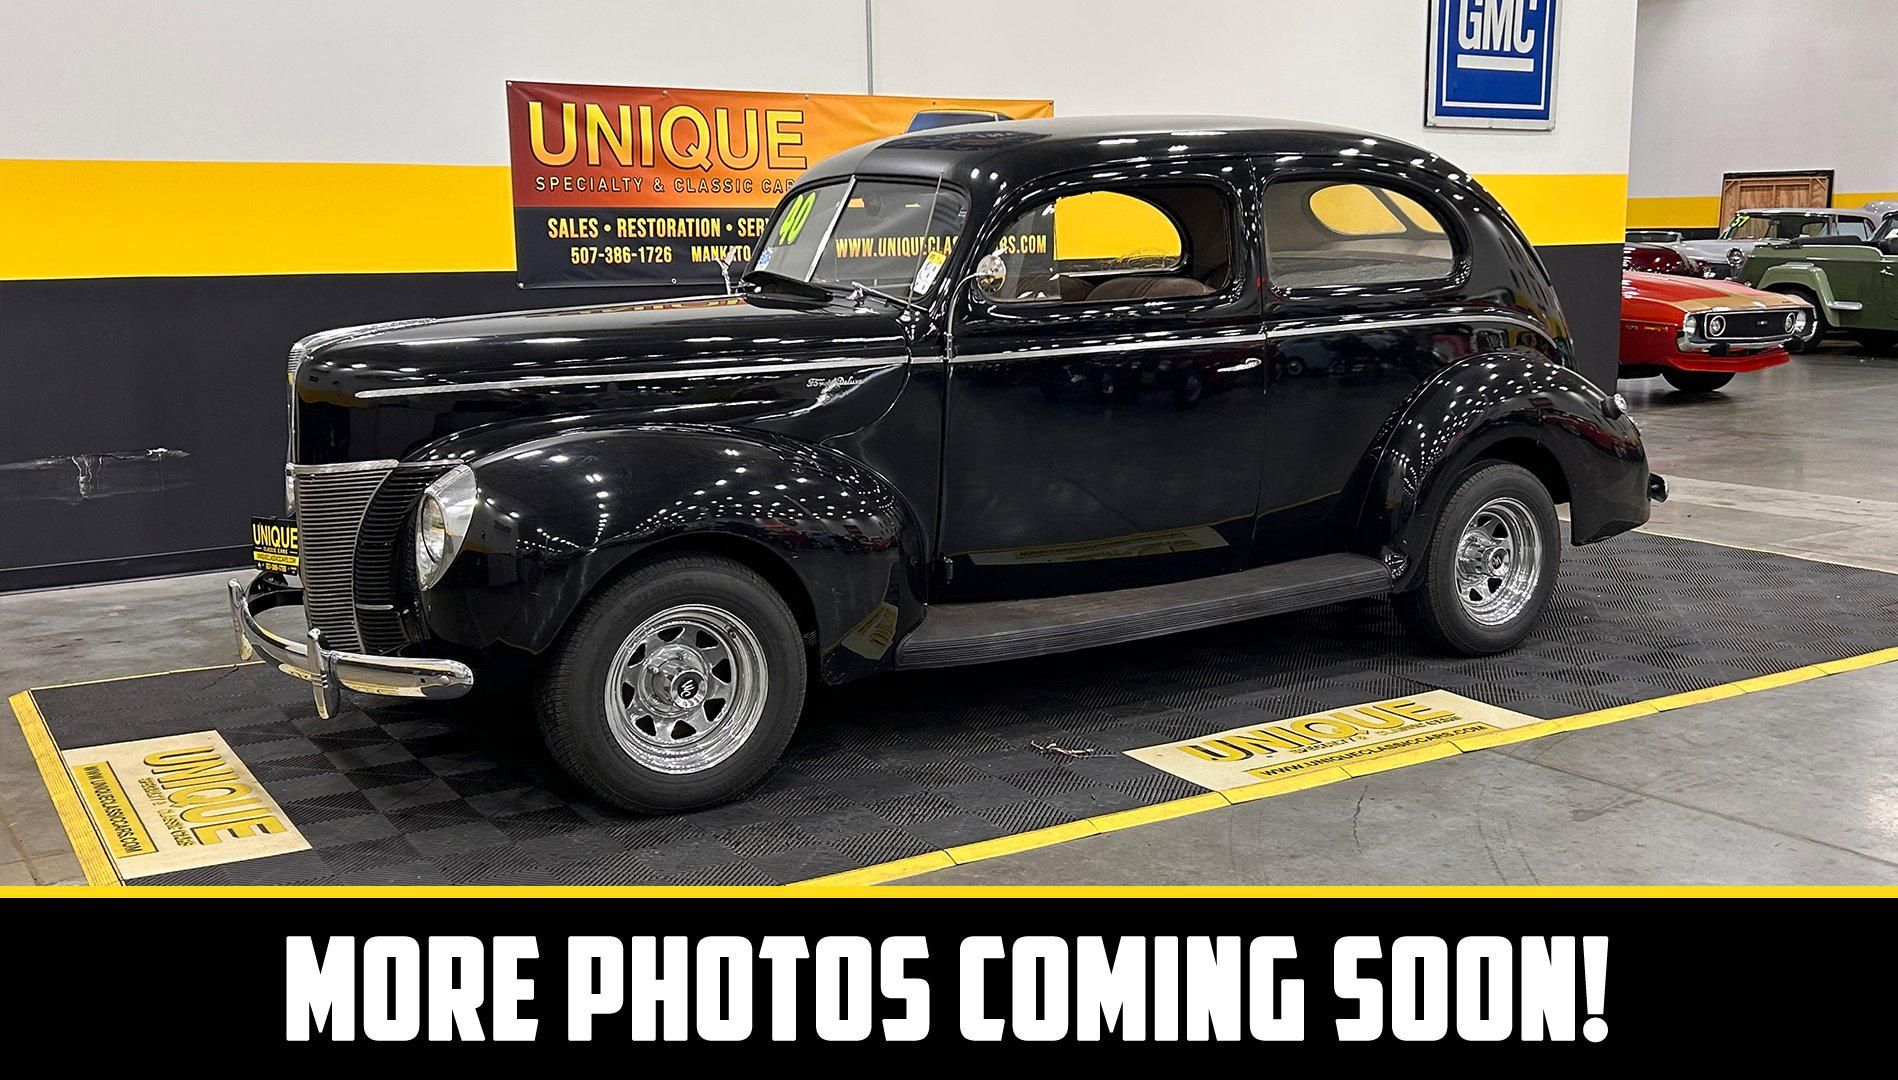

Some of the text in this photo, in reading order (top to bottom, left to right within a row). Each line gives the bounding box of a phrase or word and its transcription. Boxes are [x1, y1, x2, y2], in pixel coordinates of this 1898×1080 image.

[1458, 0, 1536, 54] GMC
[528, 101, 808, 172] UNIQUE
[535, 176, 797, 194] SPECIALTY & CLASSIC CAR
[547, 217, 770, 239] SALES RESTORATION SER
[779, 191, 816, 246] 40
[570, 246, 673, 265] 507-386-1726
[252, 523, 298, 549] UNIQUE
[1180, 699, 1456, 763] UNIQUE
[1258, 722, 1491, 777] WWW.UNIQUECLASSICCARS.COM
[83, 765, 144, 853] WWW.UNIQUECLASSICCARS.COM
[143, 744, 288, 846] UNIQUE
